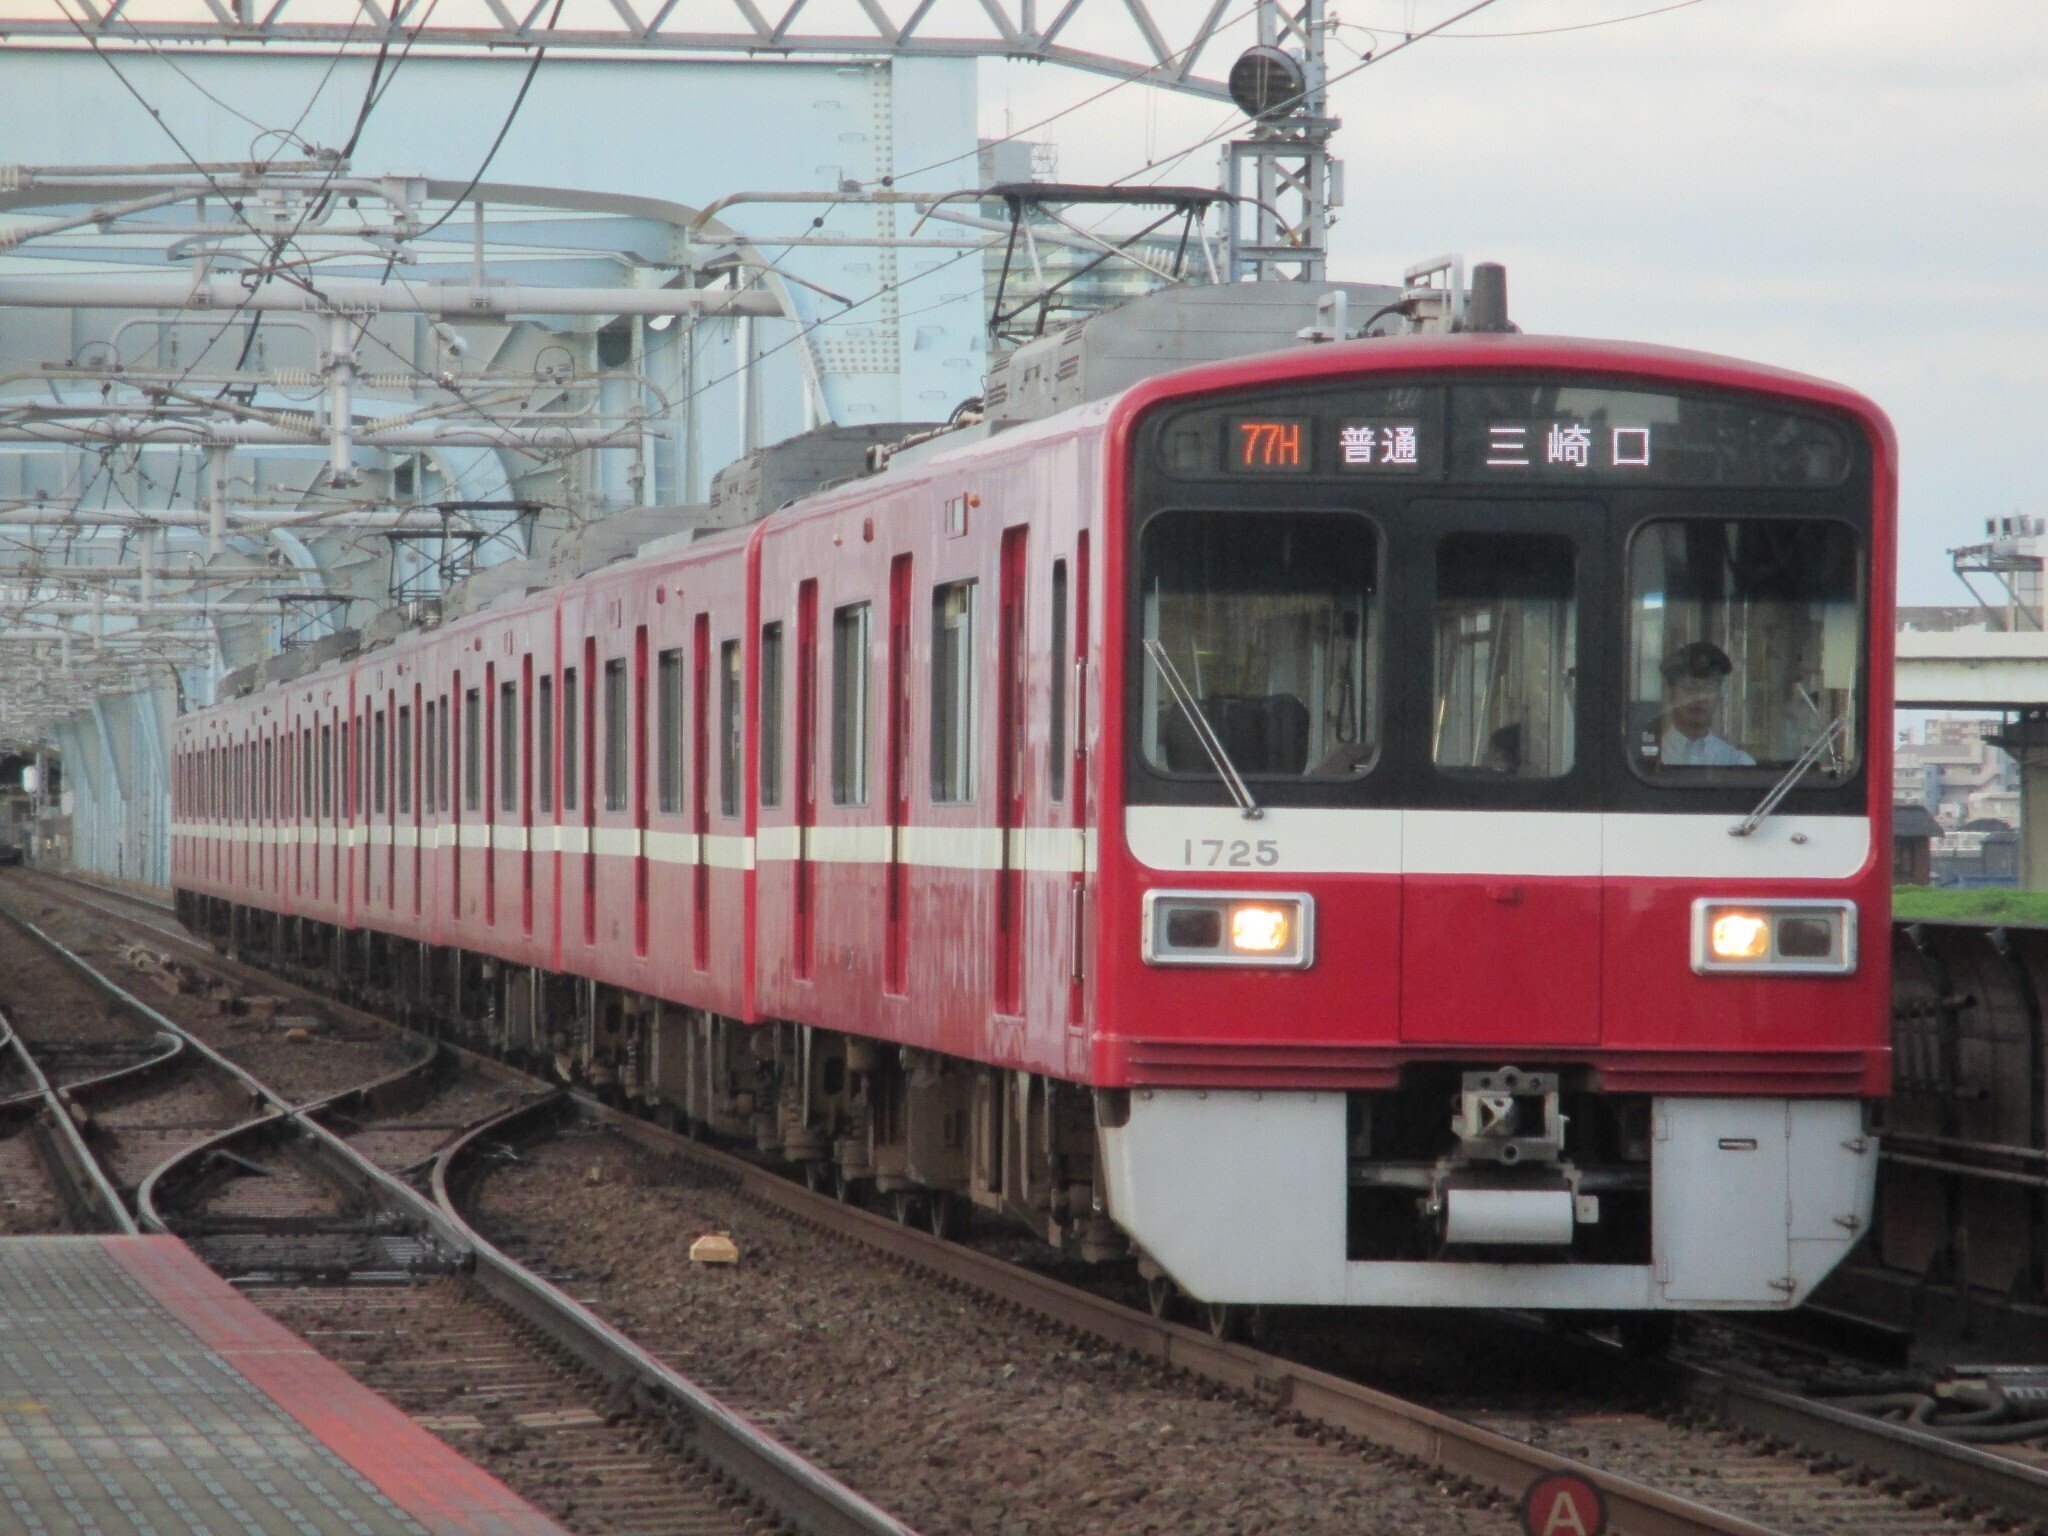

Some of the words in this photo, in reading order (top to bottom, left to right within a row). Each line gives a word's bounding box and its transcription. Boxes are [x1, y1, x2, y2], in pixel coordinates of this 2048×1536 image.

[1240, 423, 1299, 465] 77H
[1339, 426, 1418, 464] 普通
[1486, 423, 1650, 467] 三崎口
[1184, 839, 1280, 867] 1725
[1542, 1490, 1587, 1536] A
